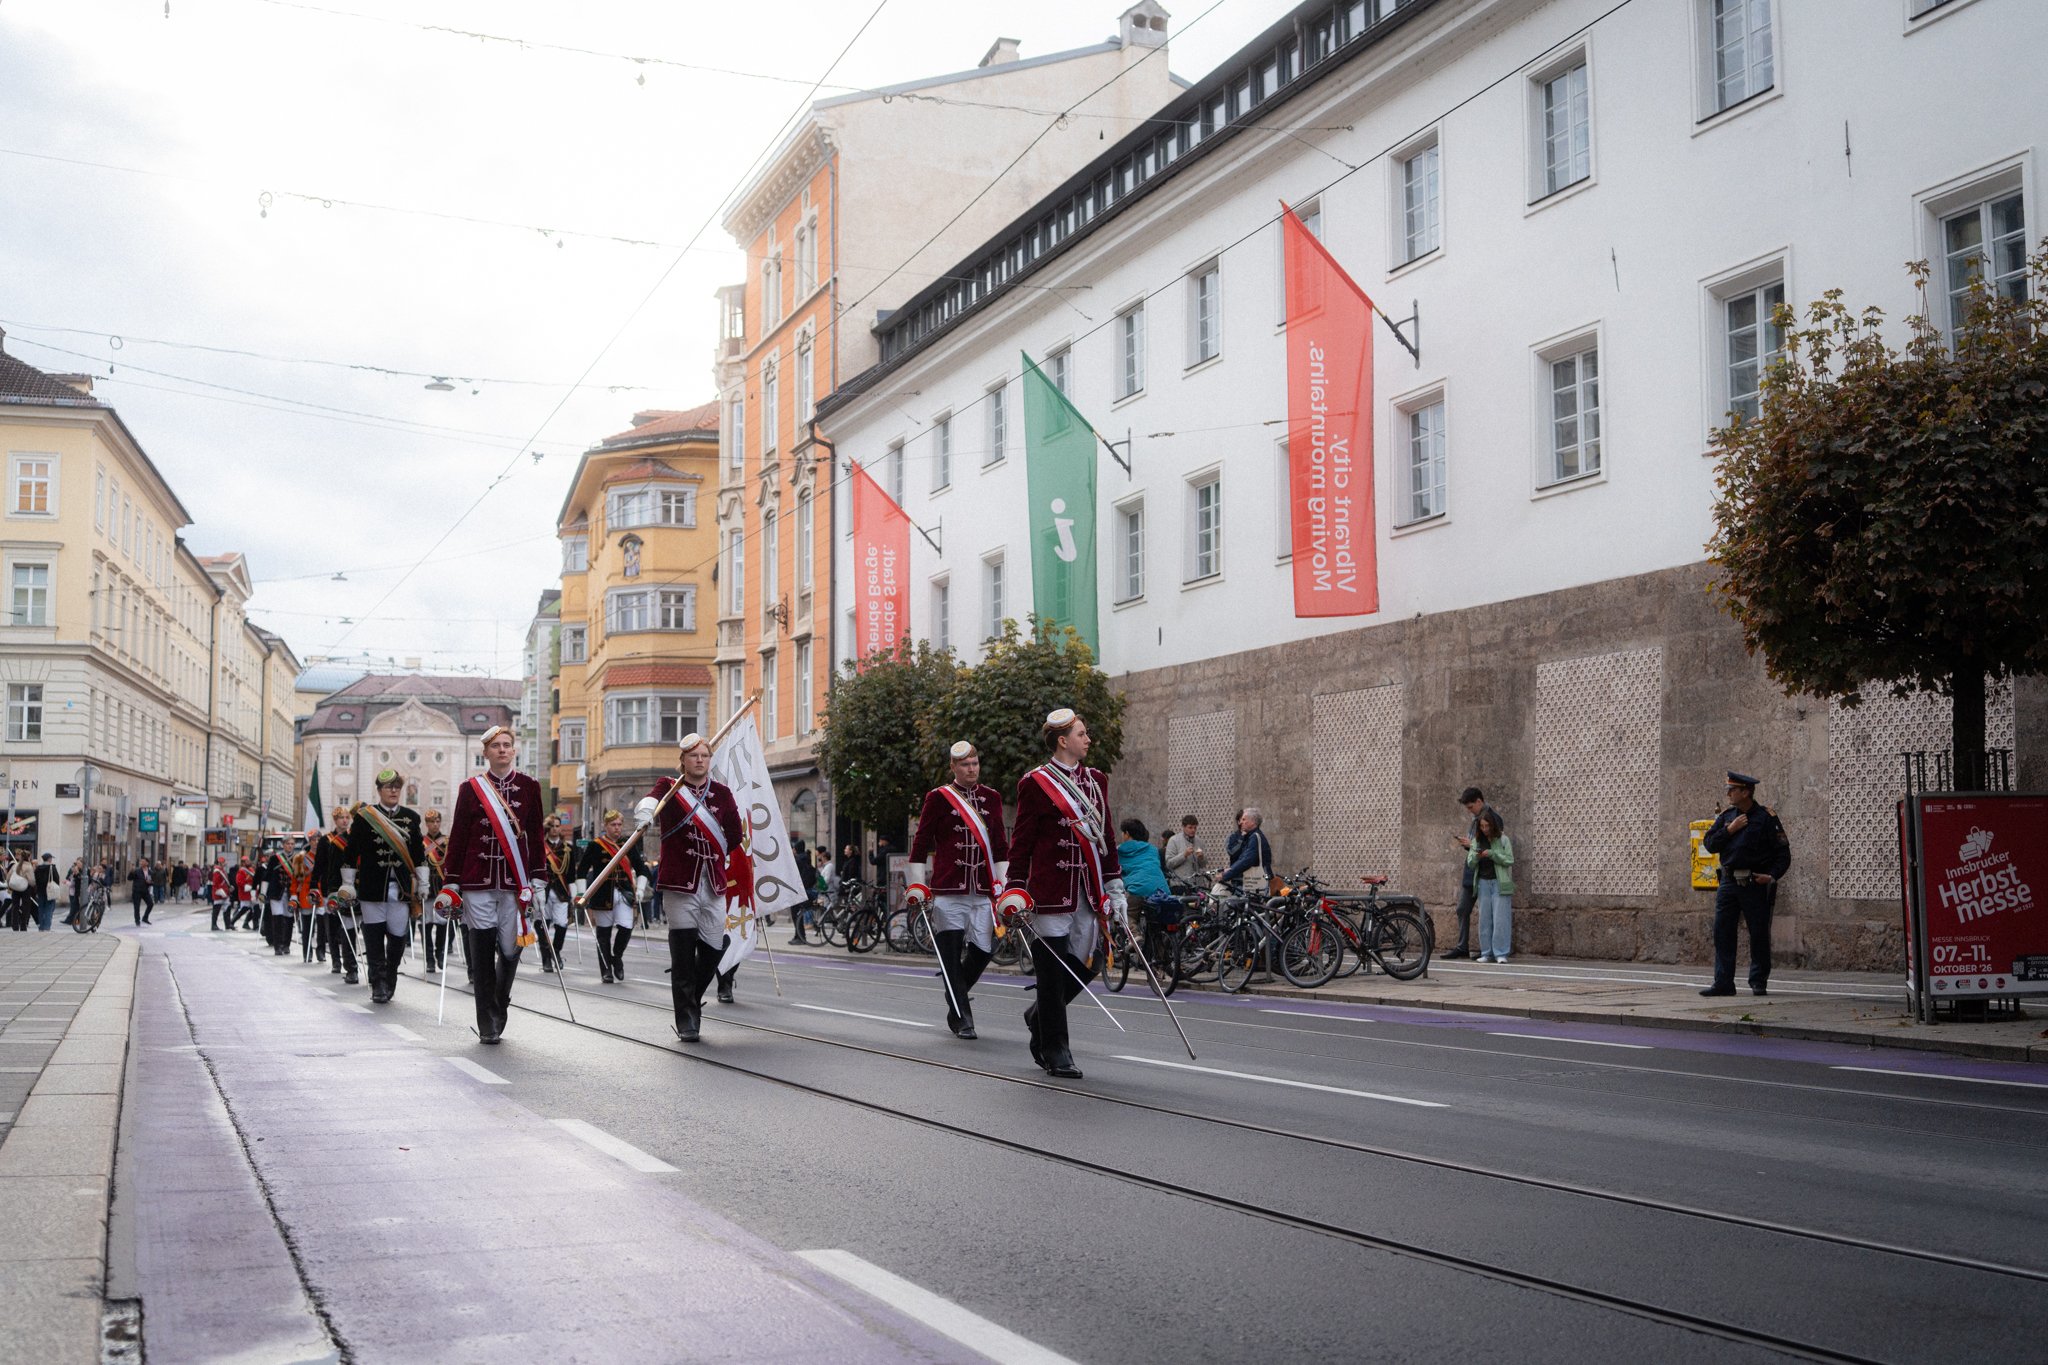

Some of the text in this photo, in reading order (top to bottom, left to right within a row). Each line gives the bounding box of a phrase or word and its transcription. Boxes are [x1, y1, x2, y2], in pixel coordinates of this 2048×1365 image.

[1945, 851, 2010, 880] Innsbrucker
[1938, 863, 2021, 908] Herbst
[1956, 884, 2032, 924] messe
[1954, 935, 1991, 943] INNSBRUCK
[1934, 964, 1977, 974] OKTOBER
